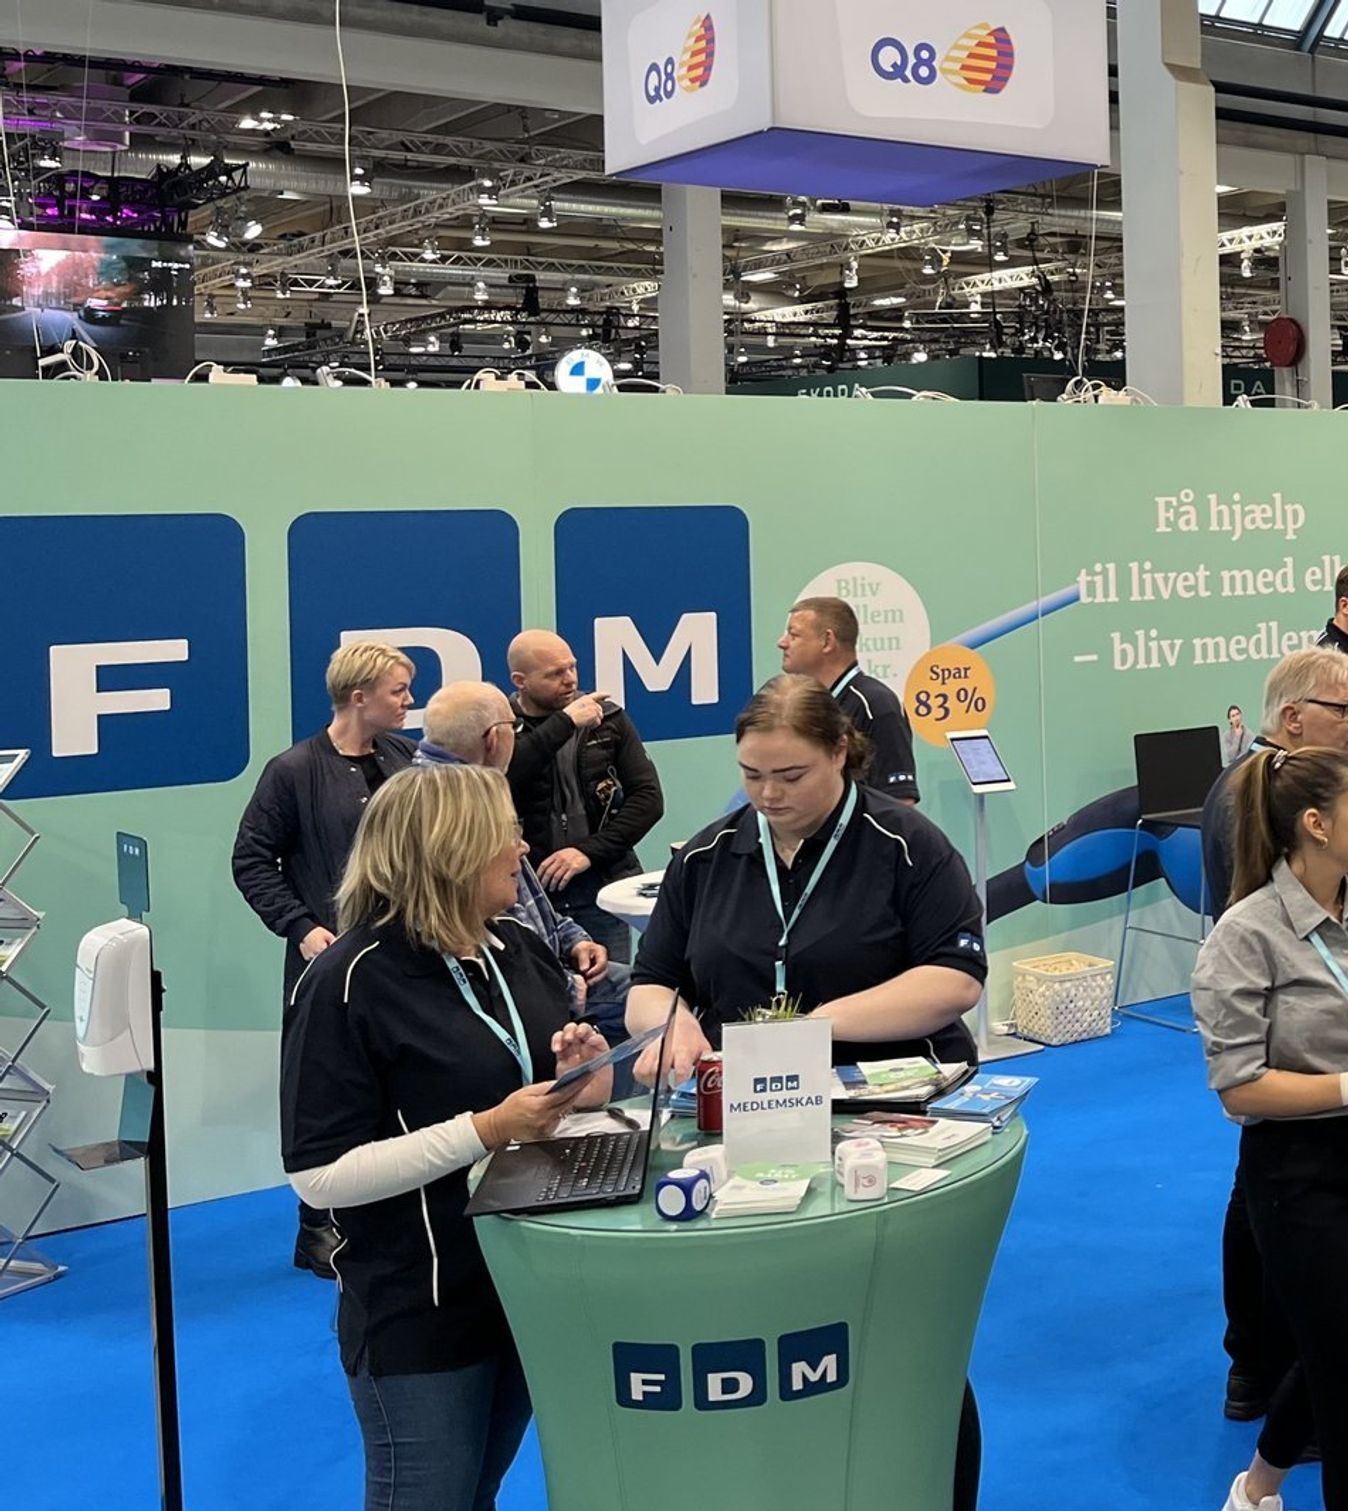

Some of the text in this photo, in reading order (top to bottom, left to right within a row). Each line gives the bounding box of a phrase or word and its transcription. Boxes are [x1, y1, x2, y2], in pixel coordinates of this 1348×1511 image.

[871, 36, 938, 86] Q8
[644, 56, 675, 105] Q8
[1155, 488, 1306, 541] Få hjælp
[835, 576, 881, 599] Bliv
[1076, 563, 1119, 604] til
[1128, 561, 1212, 601] livet
[1220, 557, 1296, 597] med
[858, 635, 900, 653] kun
[1110, 629, 1184, 671] bliv
[49, 611, 719, 757] FDM
[867, 660, 898, 678] kr.
[929, 664, 971, 685] Spar
[914, 686, 987, 721] 83 %
[729, 1095, 823, 1113] MEDLEMSKAB
[756, 1080, 799, 1092] FDM
[630, 1353, 838, 1401] FDM
